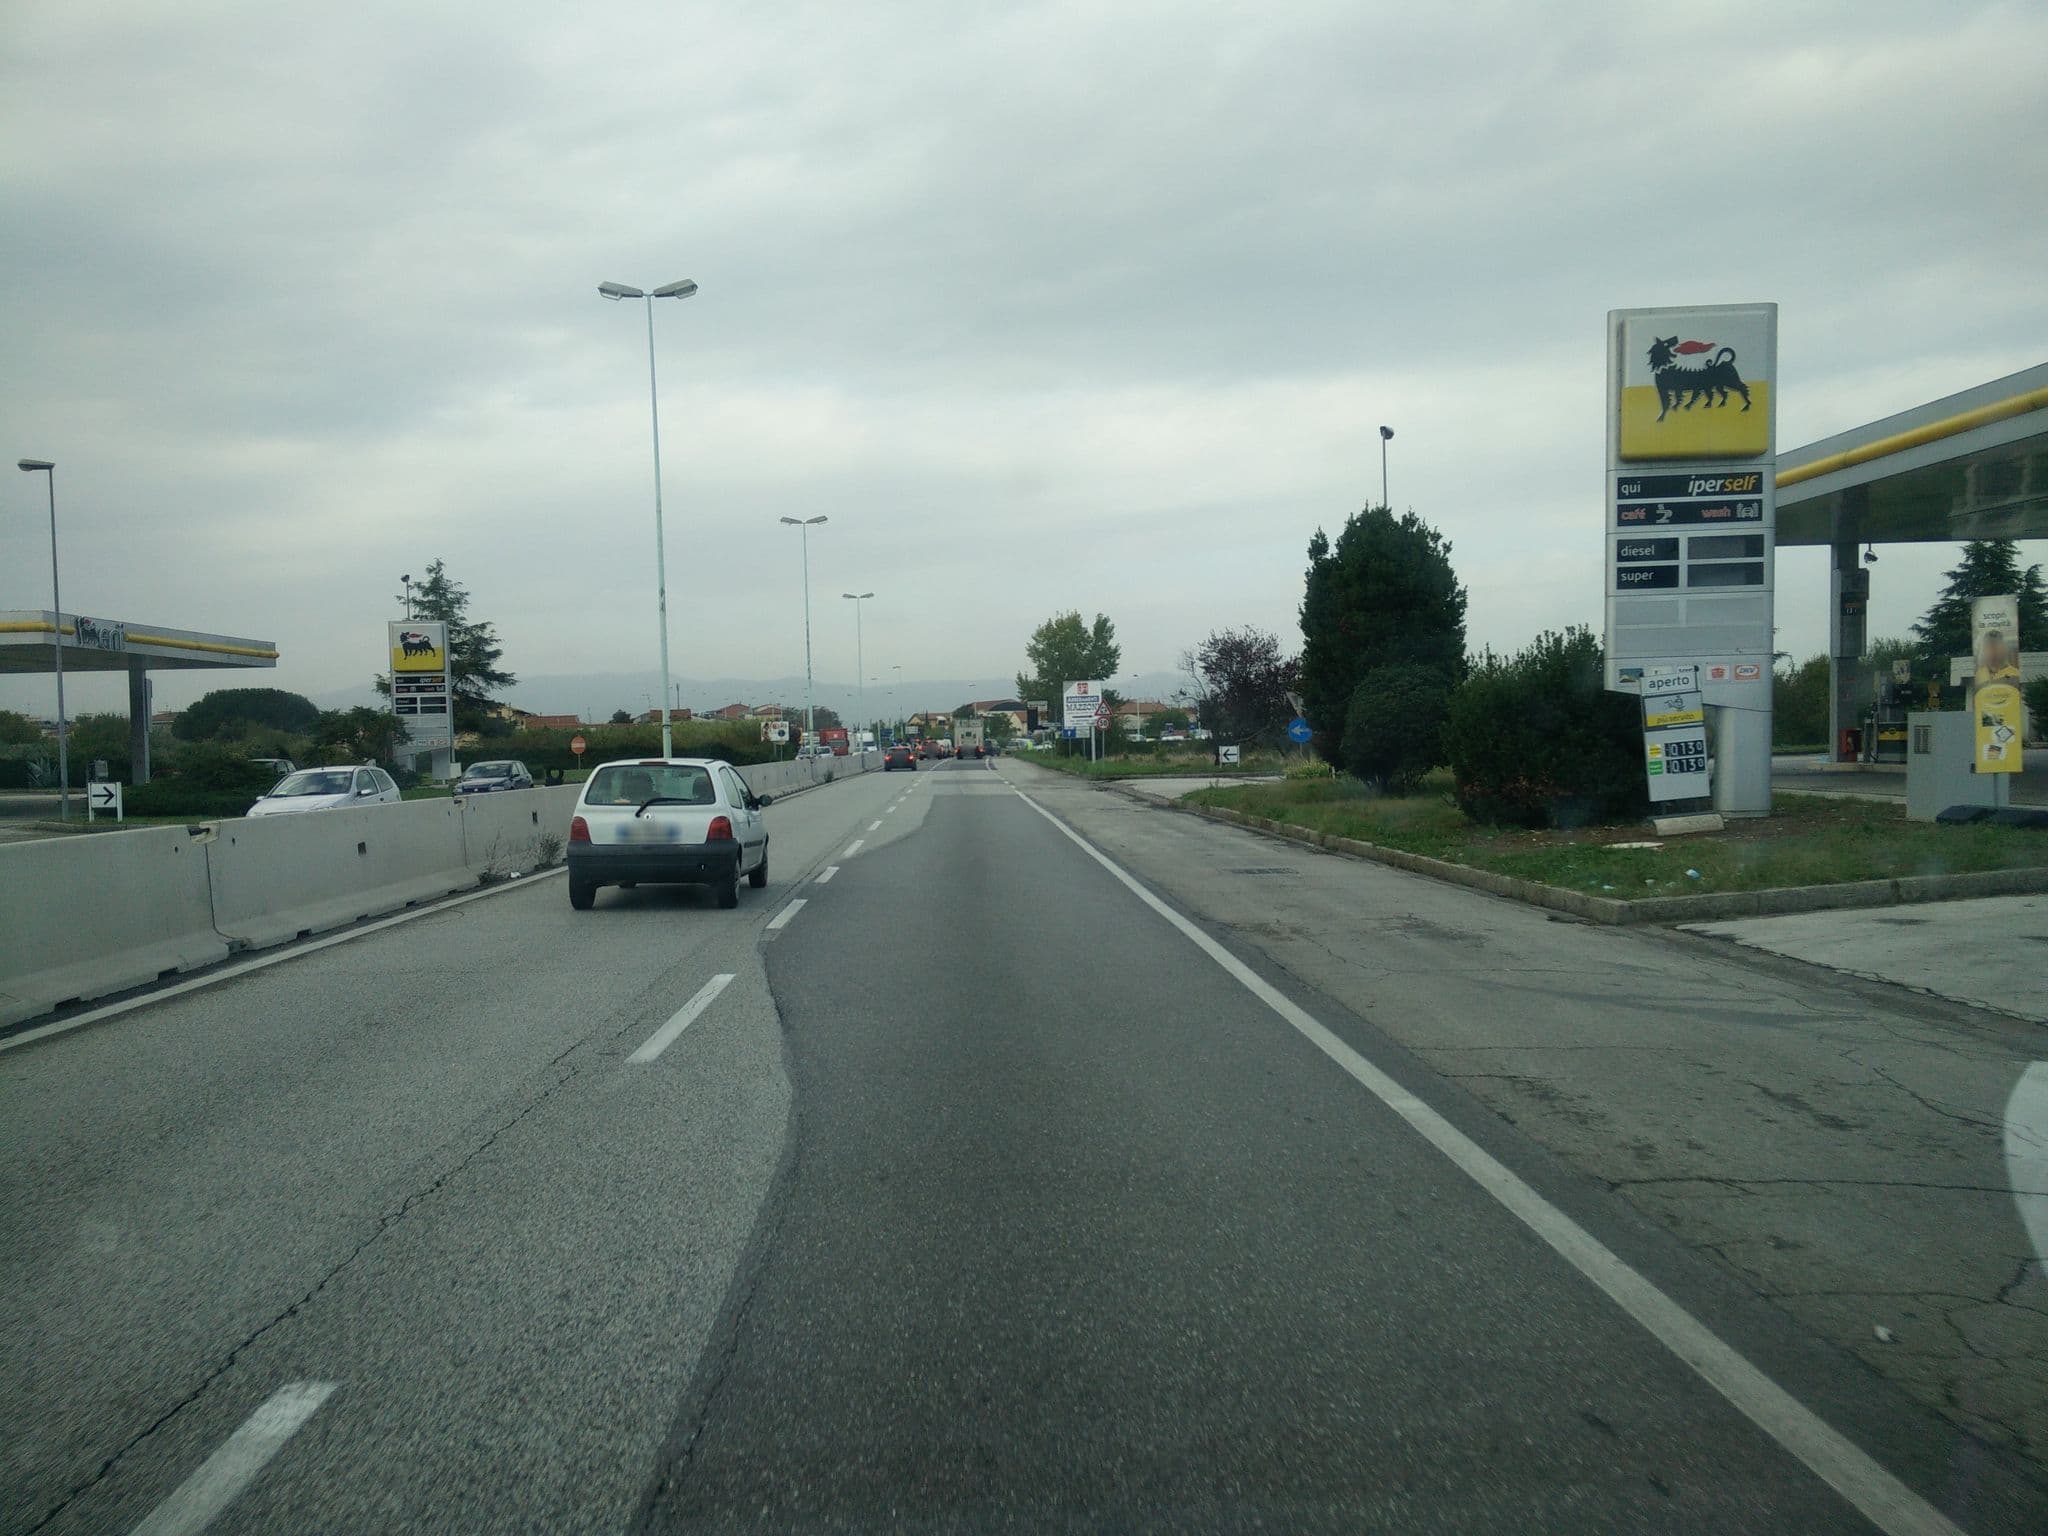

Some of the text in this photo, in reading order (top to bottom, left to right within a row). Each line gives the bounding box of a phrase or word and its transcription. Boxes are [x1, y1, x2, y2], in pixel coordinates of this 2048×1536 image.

[1621, 475, 1759, 496] qui iperself
[1620, 544, 1655, 558] diesel
[1620, 569, 1654, 584] super
[1648, 676, 1690, 690] aperto
